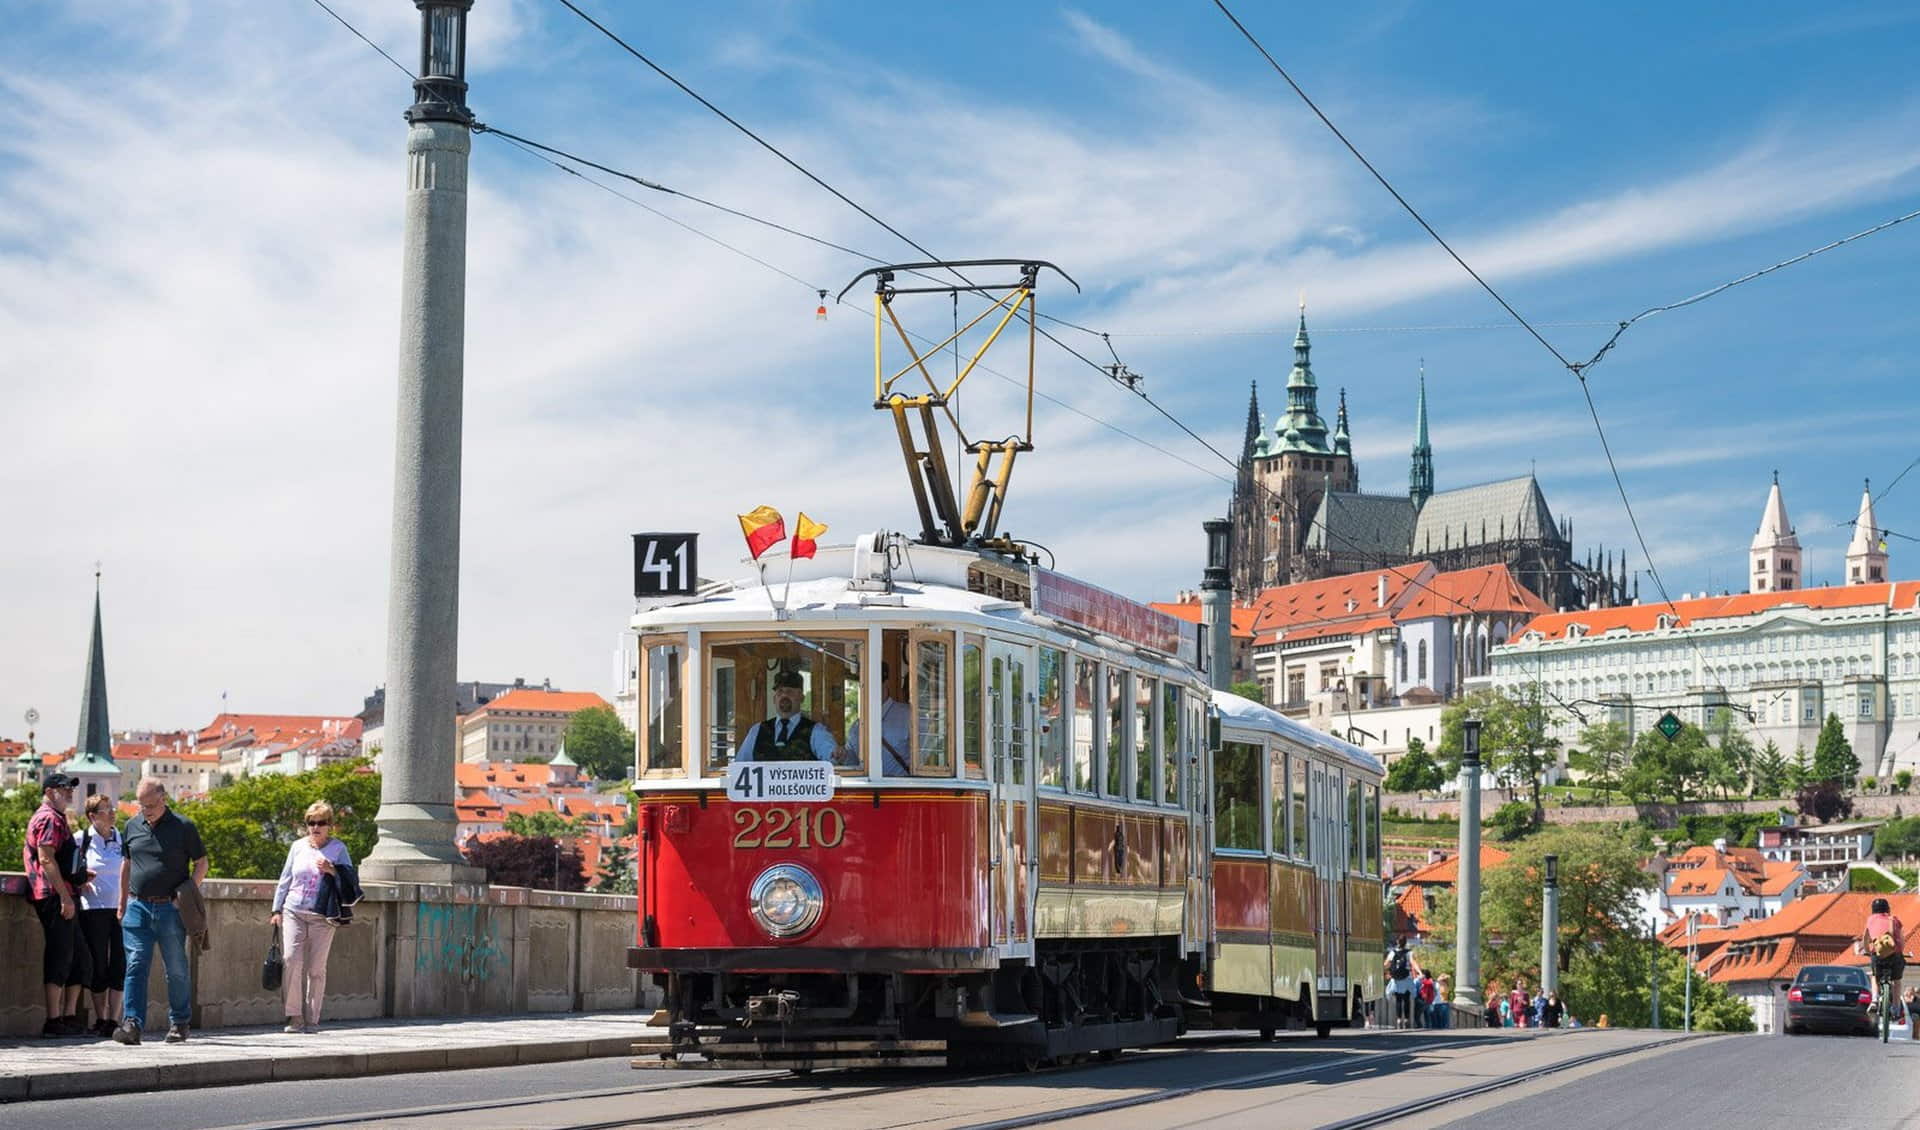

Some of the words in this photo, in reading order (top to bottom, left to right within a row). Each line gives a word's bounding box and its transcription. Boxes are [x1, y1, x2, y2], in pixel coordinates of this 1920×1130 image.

[642, 540, 688, 590] 41
[734, 766, 764, 797] 41
[769, 767, 825, 780] VÝSTAVIŠTĚ
[768, 783, 827, 796] HOLEŠOVICE
[734, 807, 845, 849] 2210
